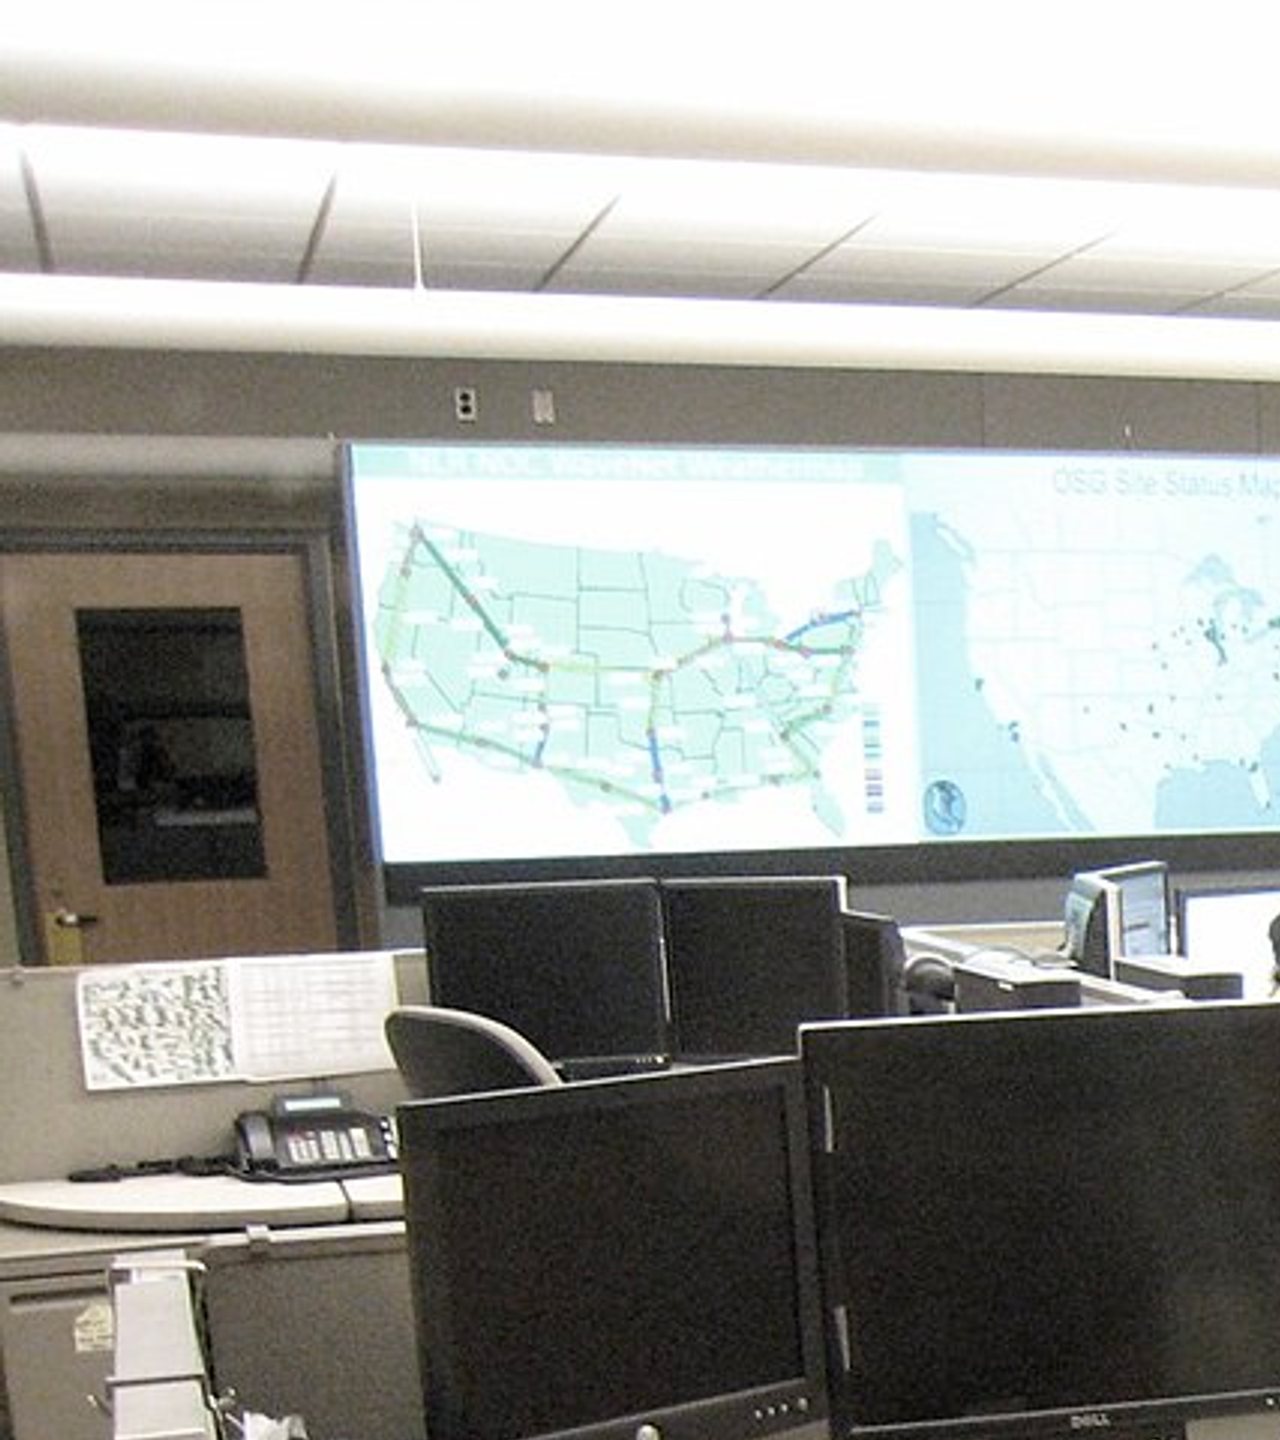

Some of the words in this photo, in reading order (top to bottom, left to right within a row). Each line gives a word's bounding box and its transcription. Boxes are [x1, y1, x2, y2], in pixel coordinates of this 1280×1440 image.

[1053, 466, 1107, 495] OSG
[1114, 467, 1157, 496] Site
[1165, 470, 1234, 498] Status
[1070, 1412, 1111, 1429] DELL
